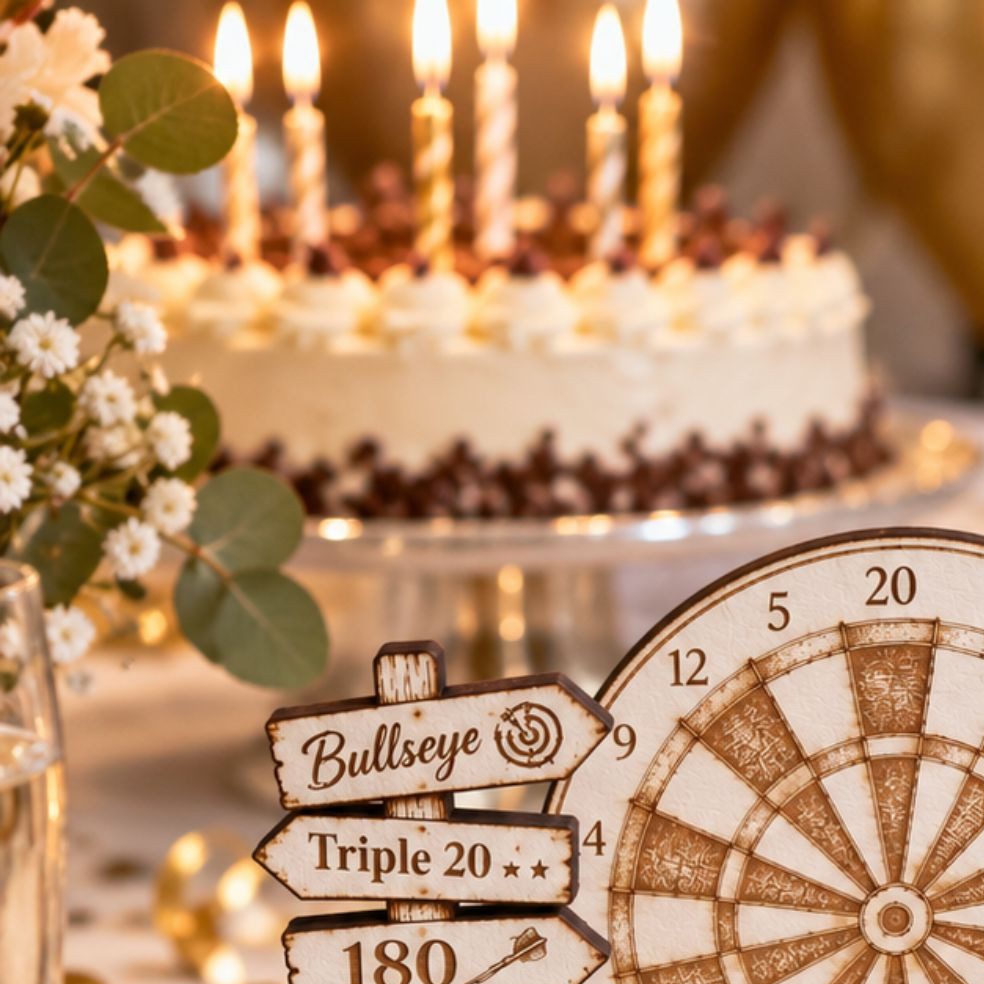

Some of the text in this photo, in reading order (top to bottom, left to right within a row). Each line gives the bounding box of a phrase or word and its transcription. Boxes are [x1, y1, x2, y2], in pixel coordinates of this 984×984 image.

[865, 565, 917, 606] 20
[767, 591, 791, 632] 5
[668, 647, 709, 687] 12
[301, 721, 482, 791] Bullseye
[612, 723, 637, 761] 9
[307, 827, 492, 884] Triple 20
[578, 819, 607, 857] 4
